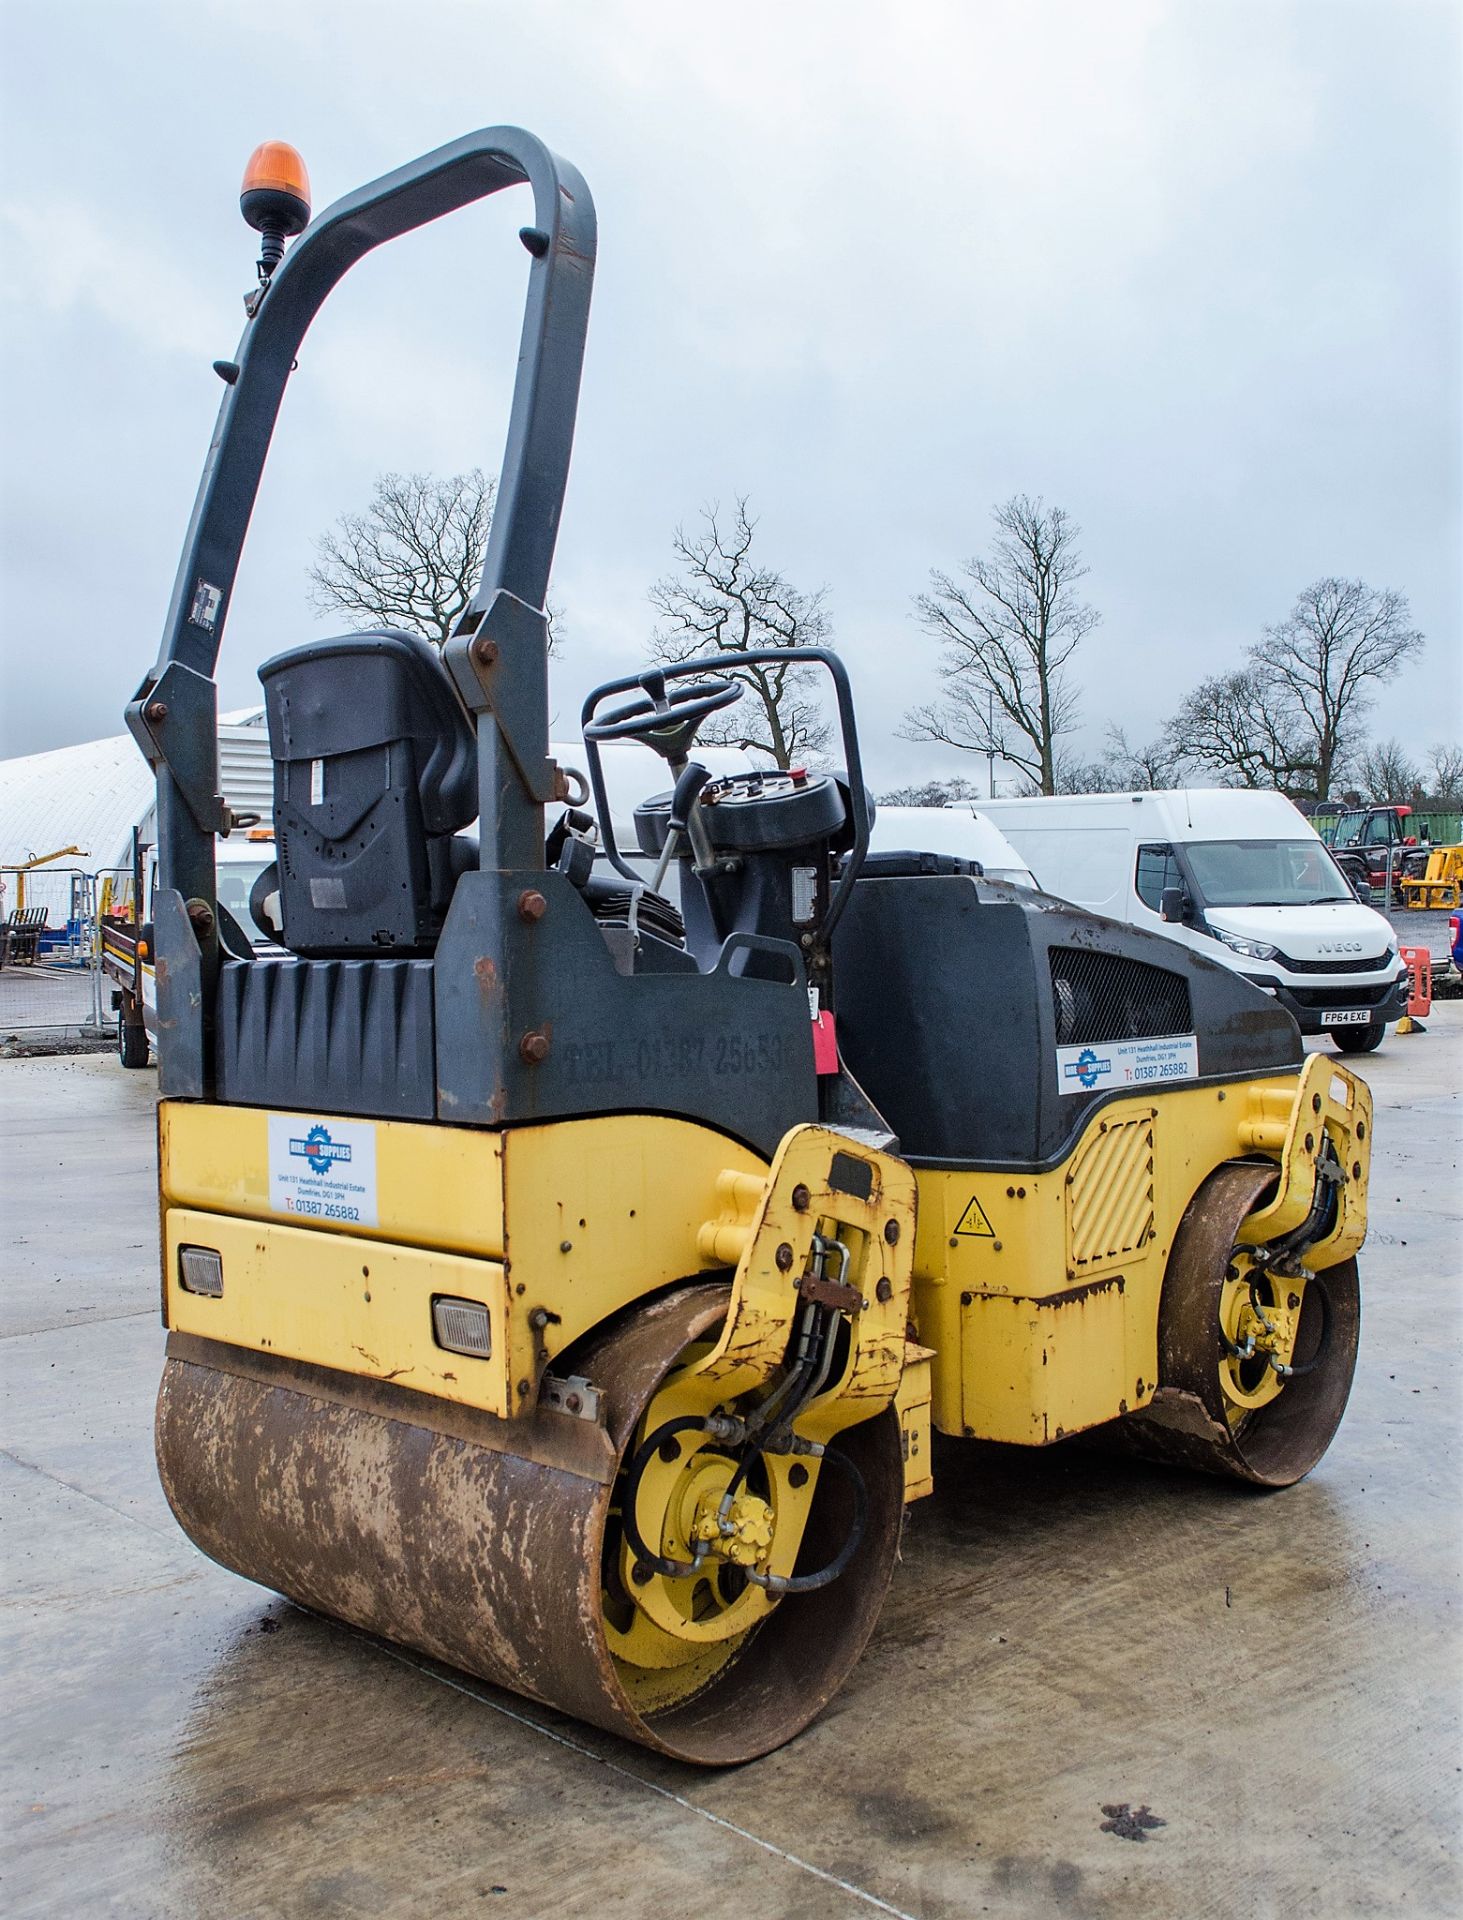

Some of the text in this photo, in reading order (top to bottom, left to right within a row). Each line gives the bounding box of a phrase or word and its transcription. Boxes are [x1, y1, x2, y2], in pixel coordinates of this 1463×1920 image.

[1318, 942, 1362, 953] IVECO
[1325, 1012, 1367, 1022] FP64 EXE
[1128, 1046, 1136, 1054] 131
[1159, 1042, 1178, 1050] Industrial
[1088, 1062, 1110, 1072] SUPPLIES
[1124, 1062, 1188, 1080] T: 01387 265882
[320, 1144, 351, 1160] SUPPLIES
[278, 1174, 289, 1182] Unit
[324, 1180, 348, 1190] Industrial
[349, 1184, 366, 1192] Estate
[322, 1190, 333, 1199] DG1
[286, 1198, 360, 1220] T: 01387 265882
